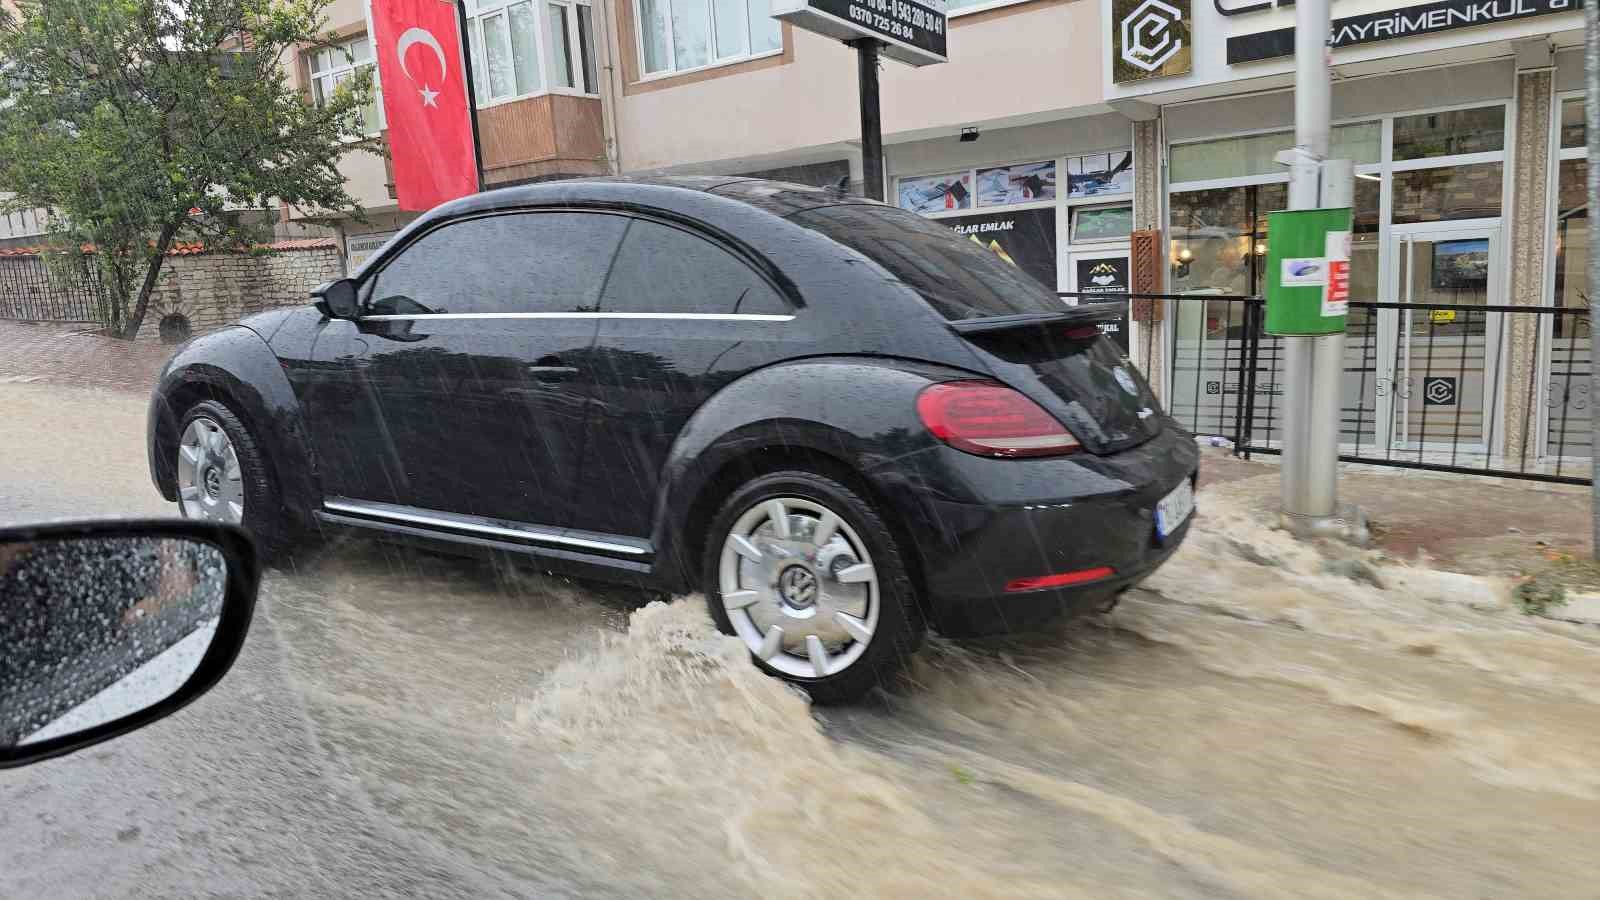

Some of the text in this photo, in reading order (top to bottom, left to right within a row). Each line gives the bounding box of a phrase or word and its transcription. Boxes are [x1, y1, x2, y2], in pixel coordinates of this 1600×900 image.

[849, 4, 872, 24] 0370
[874, 14, 890, 31] 725
[902, 26, 914, 40] 84
[980, 220, 1015, 233] EMLAK
